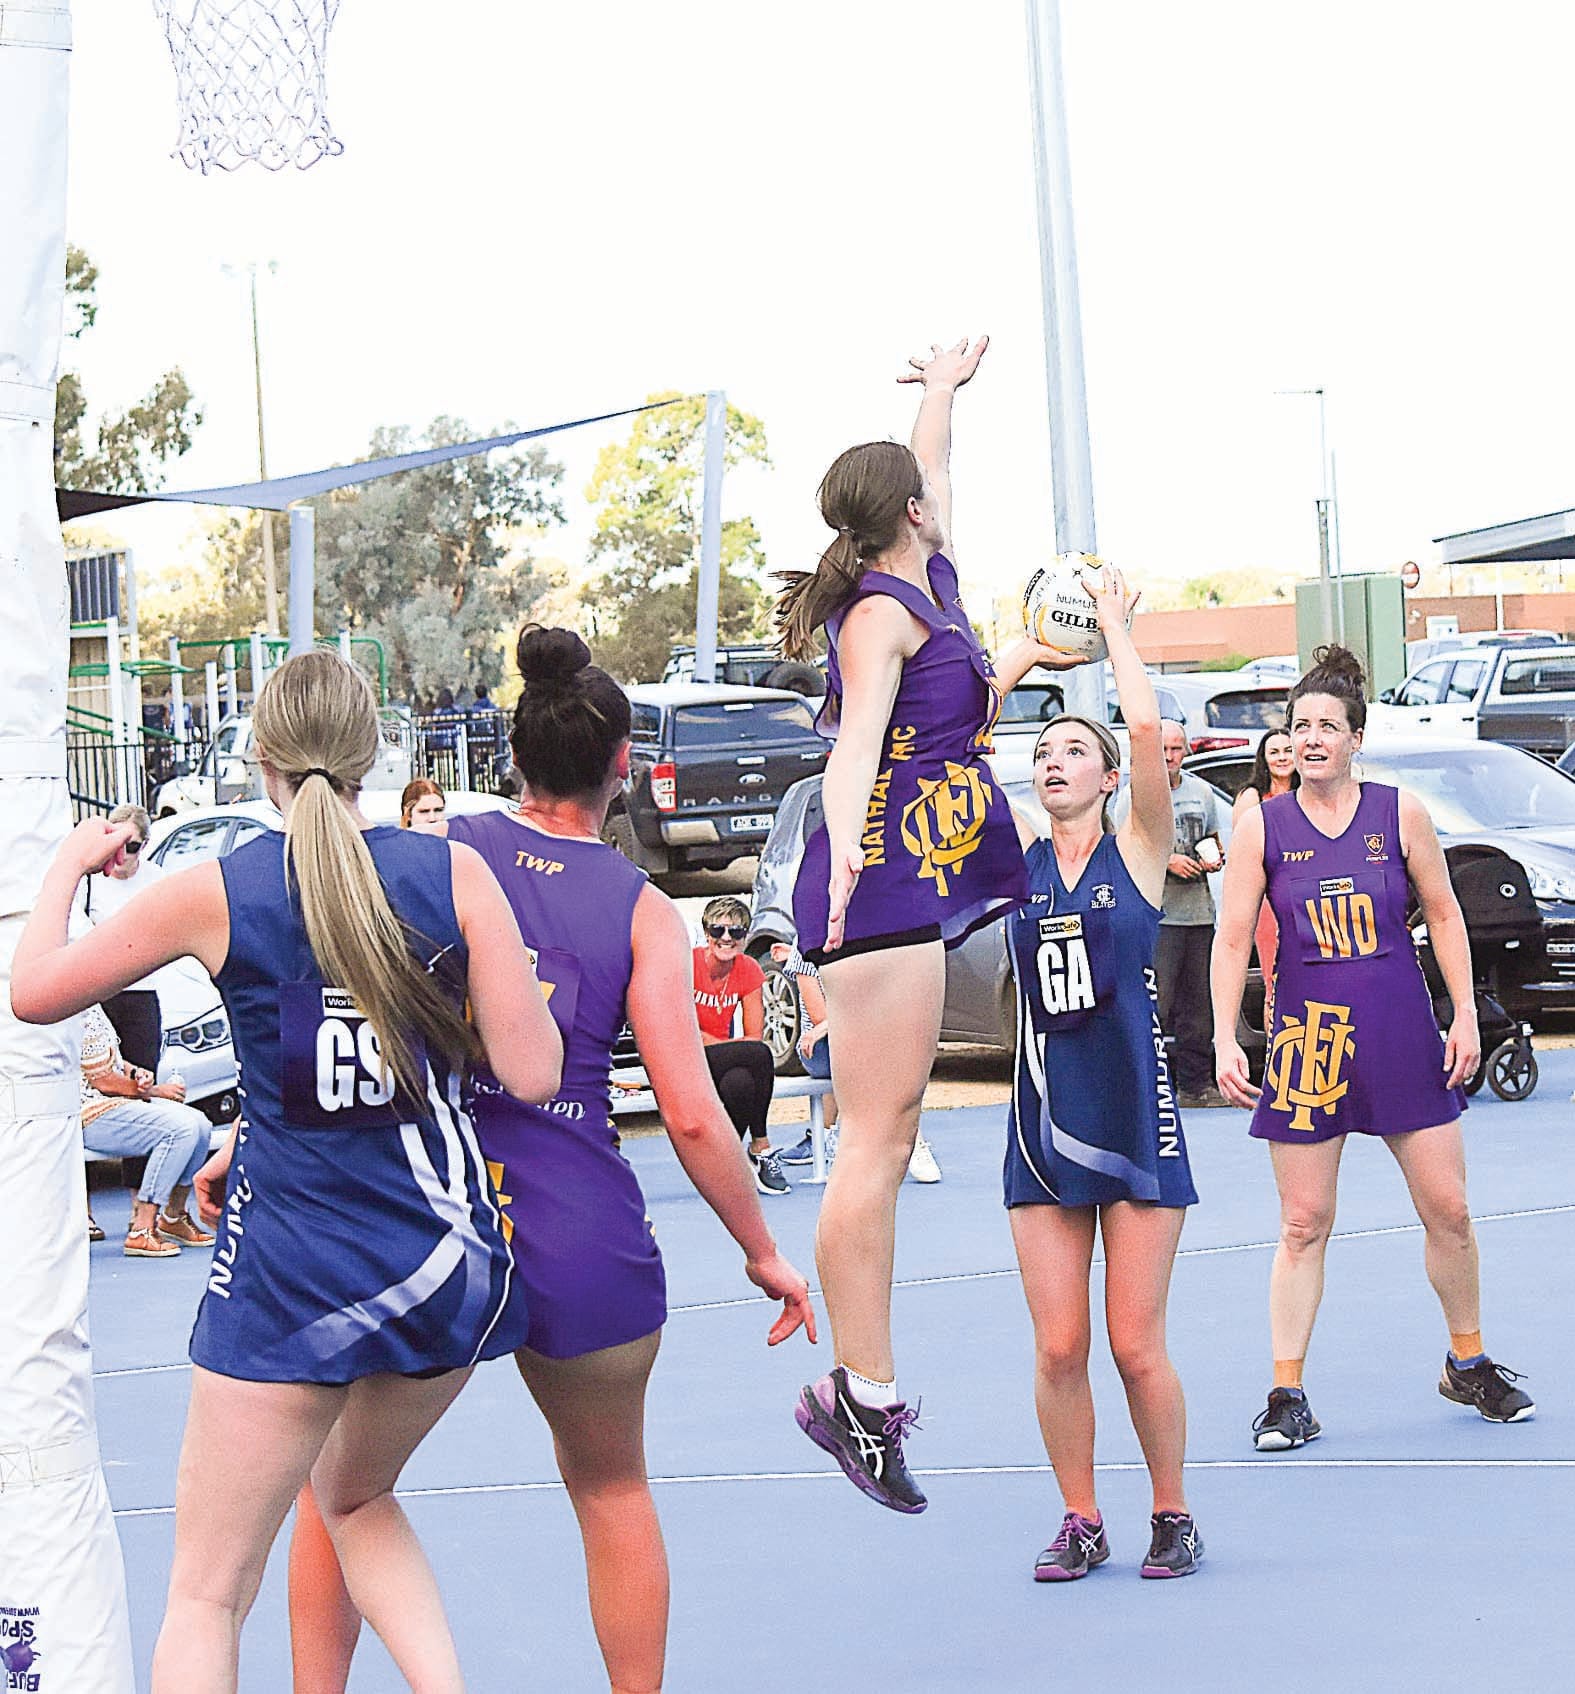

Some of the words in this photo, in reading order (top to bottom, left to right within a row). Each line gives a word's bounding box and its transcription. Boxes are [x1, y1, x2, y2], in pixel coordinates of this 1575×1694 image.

[1051, 610, 1103, 630] GILB
[515, 850, 565, 876] TWP
[1282, 850, 1315, 862] TWP
[1305, 893, 1378, 959] WD
[1036, 938, 1096, 1015] GA
[316, 1018, 396, 1112] GS
[0, 1618, 35, 1638] SPO
[6, 1672, 41, 1693] BUF
